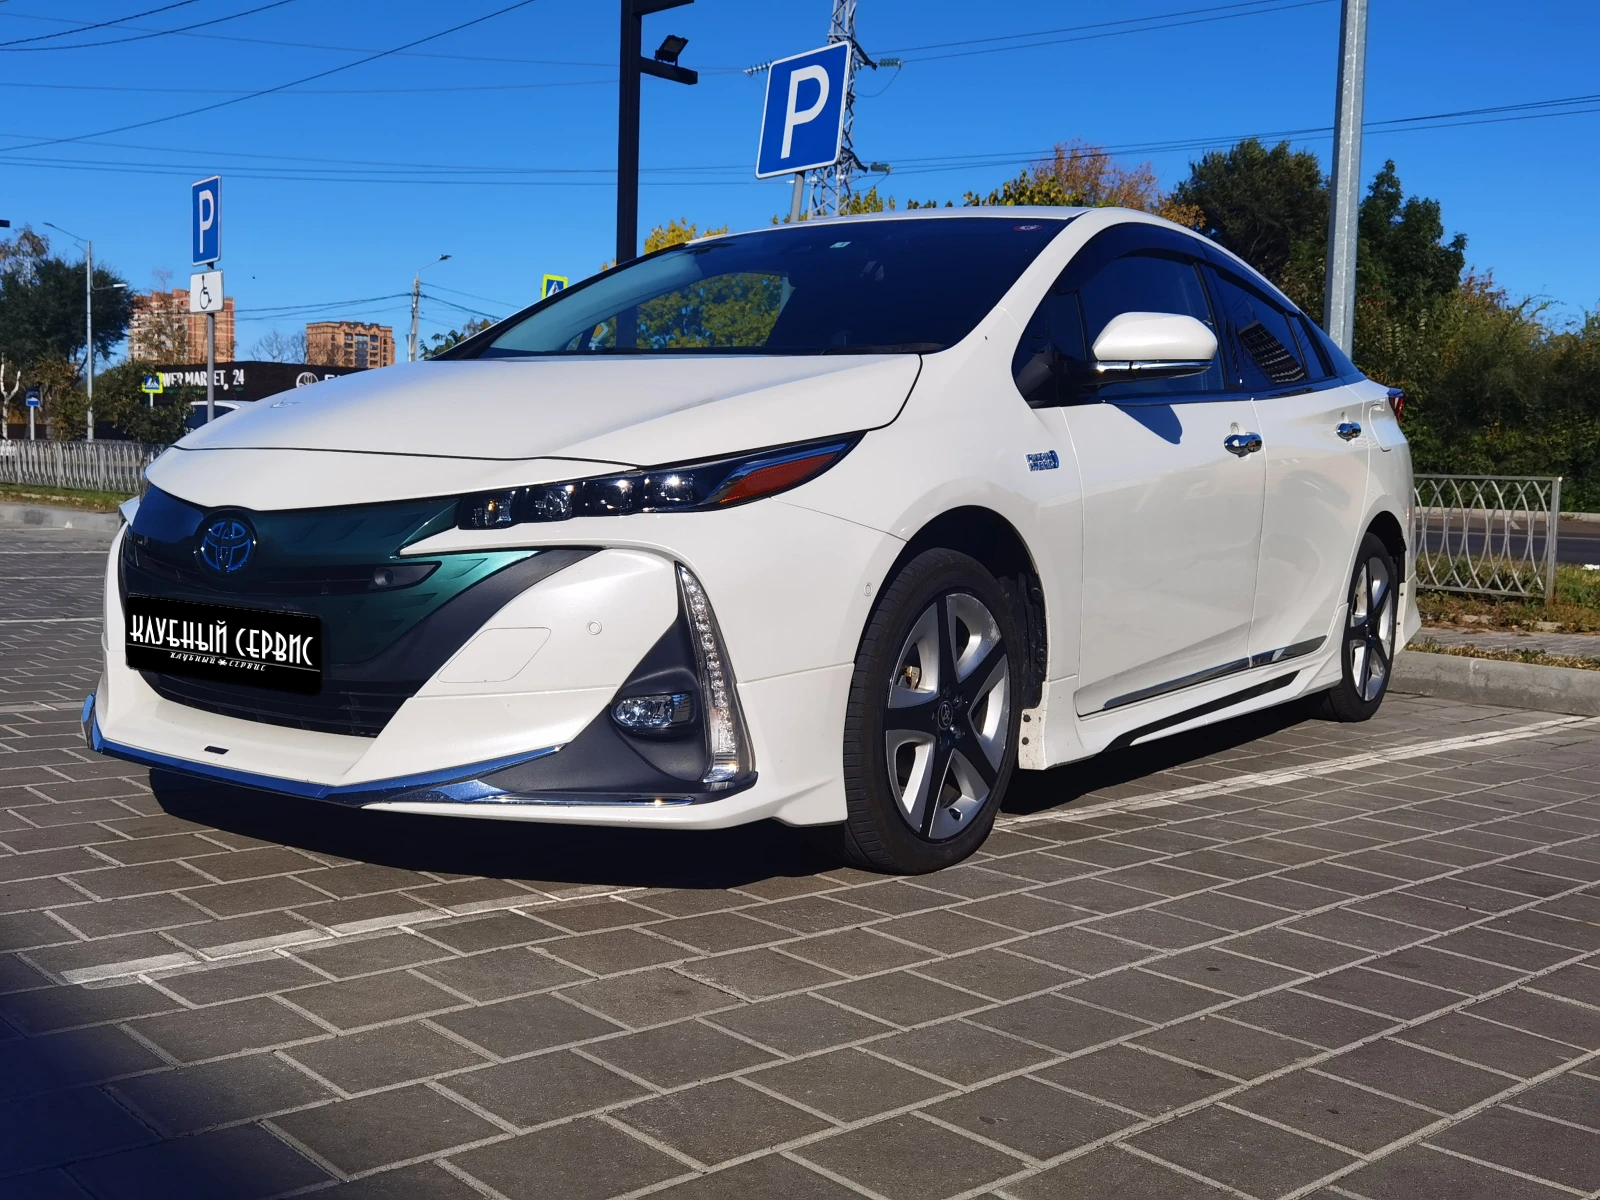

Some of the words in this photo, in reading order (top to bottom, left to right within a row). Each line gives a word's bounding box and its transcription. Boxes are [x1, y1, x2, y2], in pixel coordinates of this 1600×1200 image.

[781, 64, 830, 159] P
[199, 189, 215, 254] P
[232, 368, 245, 386] 24
